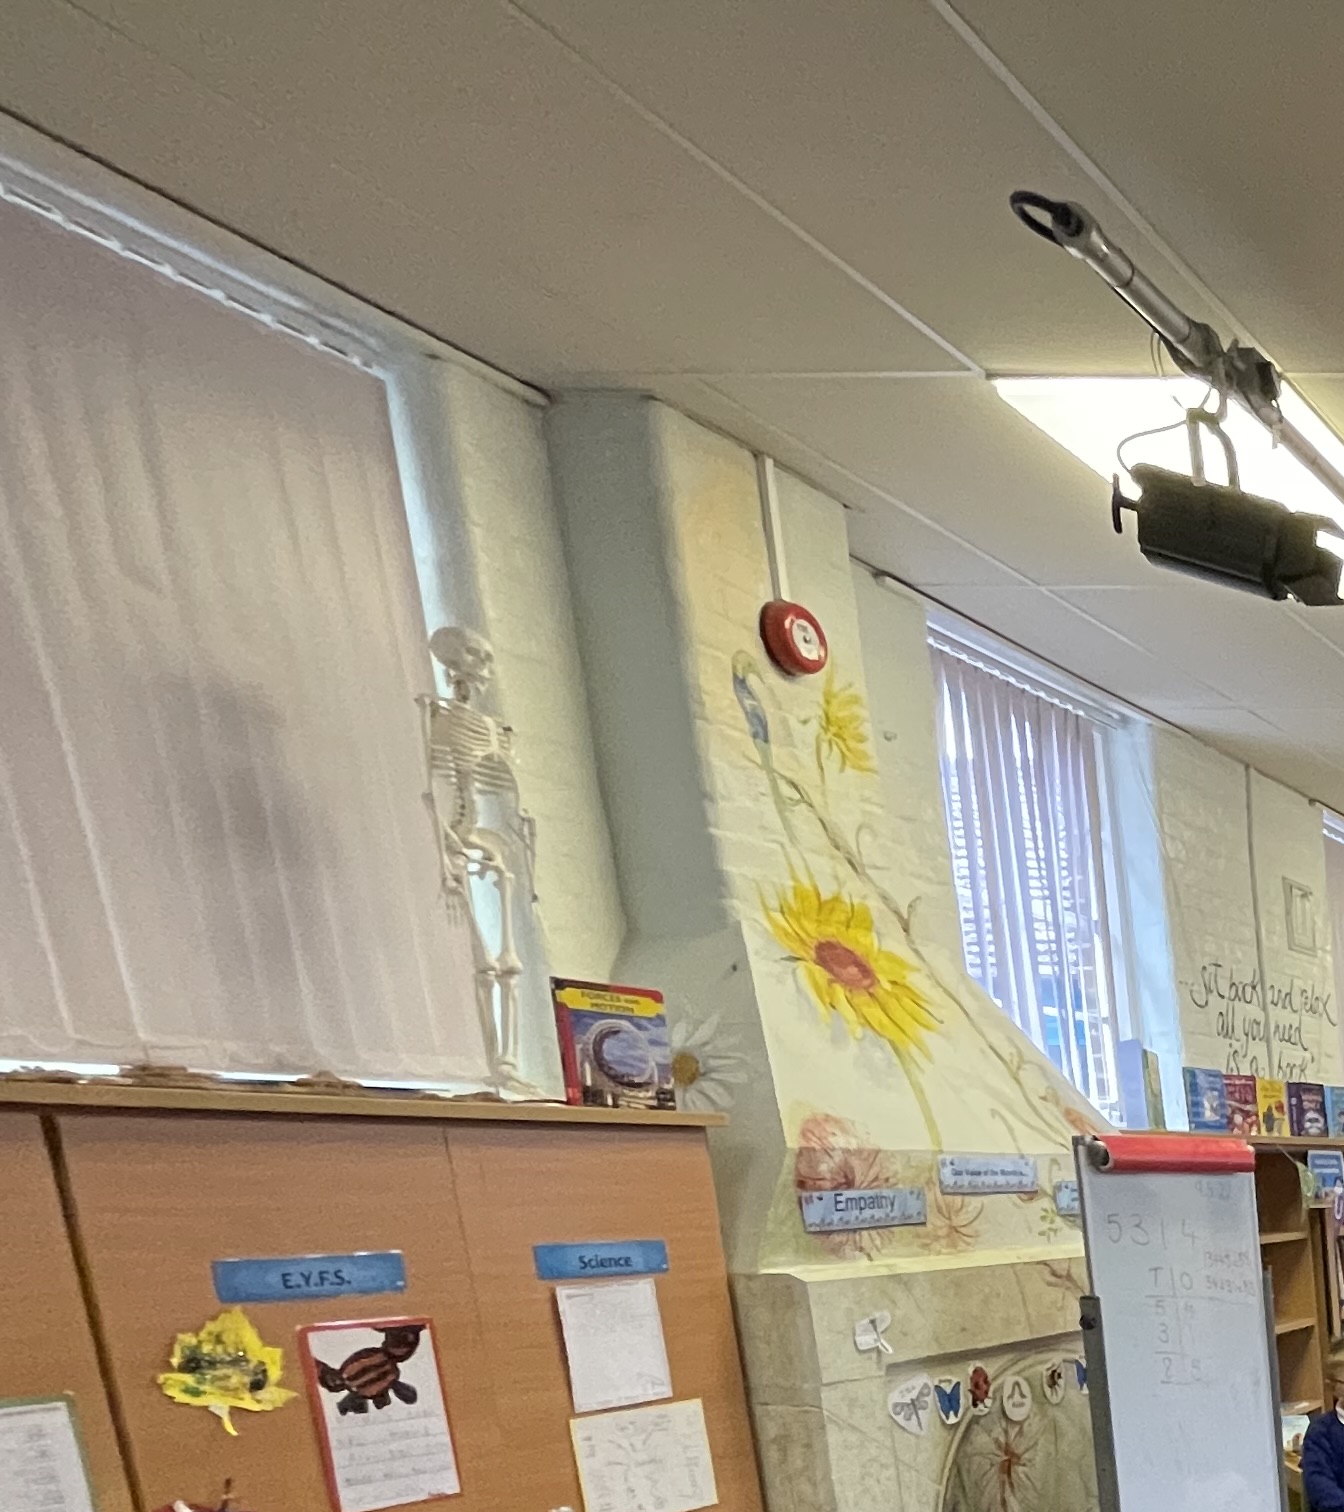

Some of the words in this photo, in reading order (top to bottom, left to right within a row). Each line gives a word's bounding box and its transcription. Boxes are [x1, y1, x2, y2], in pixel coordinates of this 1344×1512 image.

[834, 1192, 897, 1214] Empathy
[578, 1253, 633, 1270] Science
[281, 1267, 353, 1290] E.Y.F.S.
